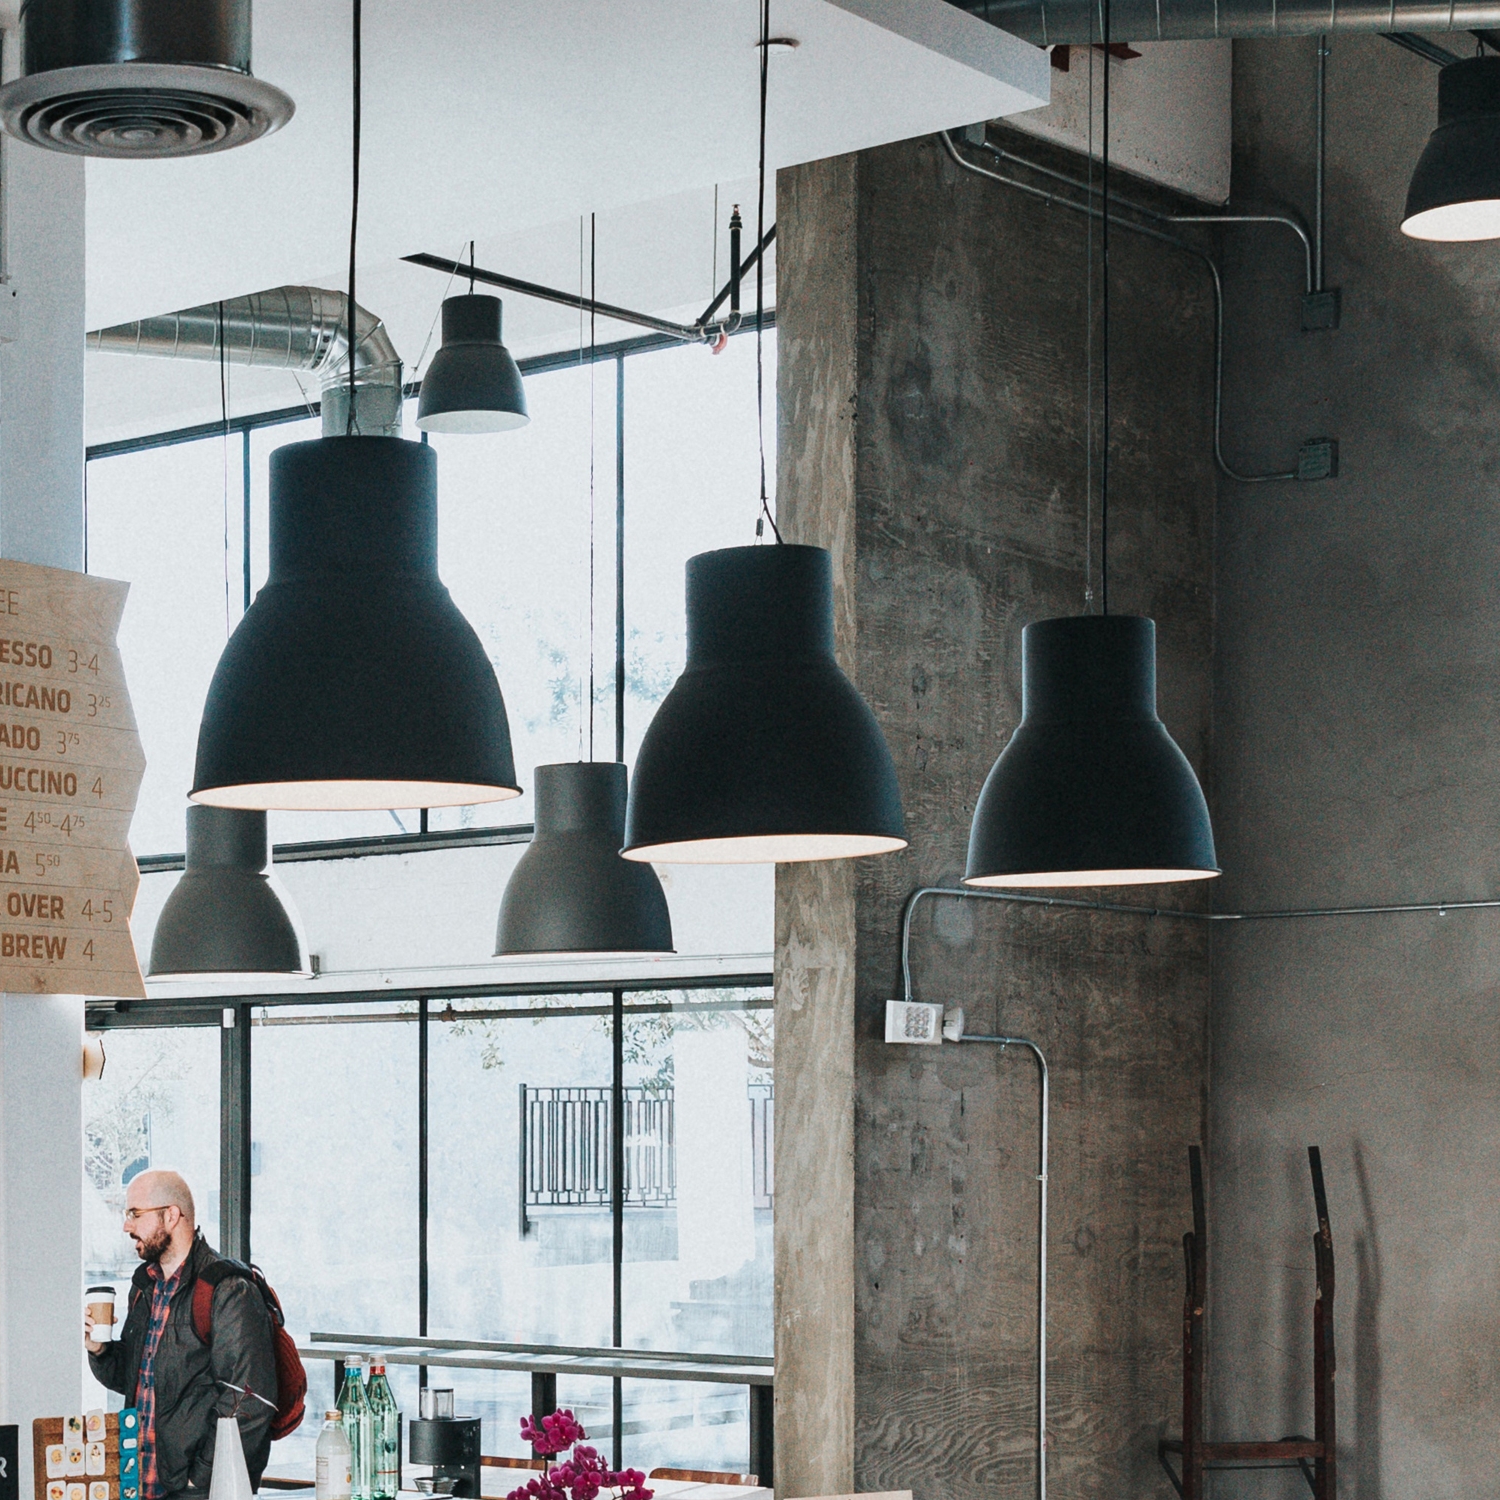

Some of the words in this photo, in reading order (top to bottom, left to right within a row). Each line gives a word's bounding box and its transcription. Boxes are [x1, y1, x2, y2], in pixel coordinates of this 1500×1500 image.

[67, 649, 101, 676] 3-4
[91, 776, 104, 799] 4
[7, 892, 65, 920] OVER
[81, 898, 113, 923] 4-5
[1, 933, 67, 961] BREW
[82, 939, 95, 962] 4
